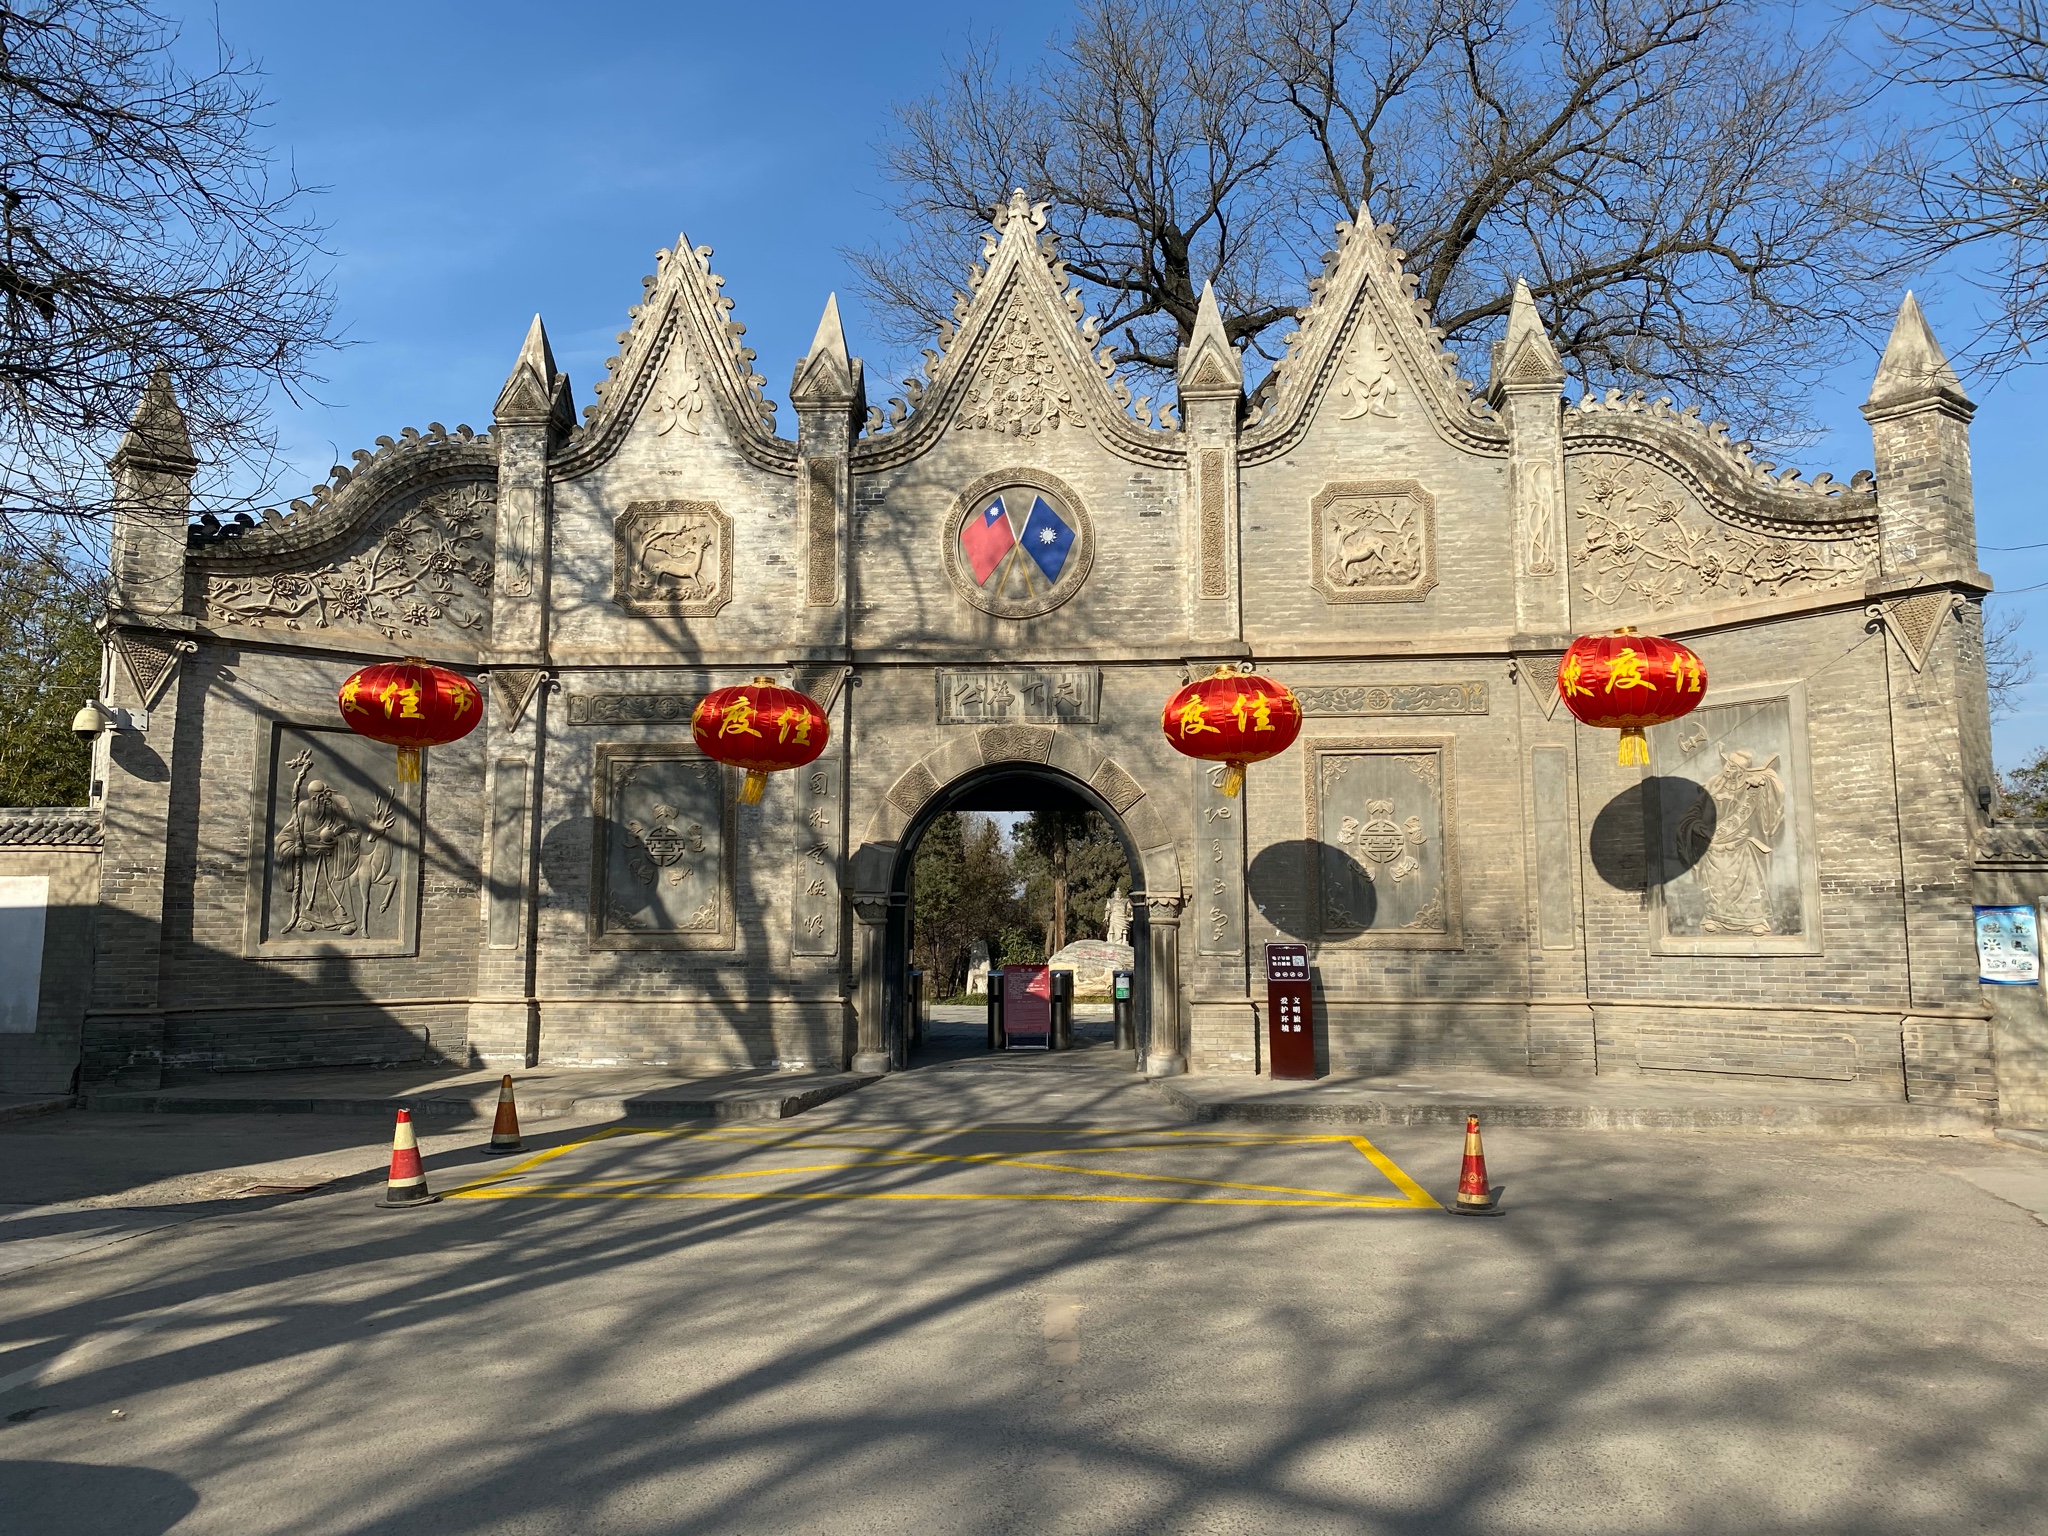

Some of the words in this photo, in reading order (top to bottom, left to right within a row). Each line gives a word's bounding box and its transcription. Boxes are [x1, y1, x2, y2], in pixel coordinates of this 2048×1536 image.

[1280, 996, 1290, 1033] 爱护环境
[1292, 996, 1302, 1033] 文明旅游
